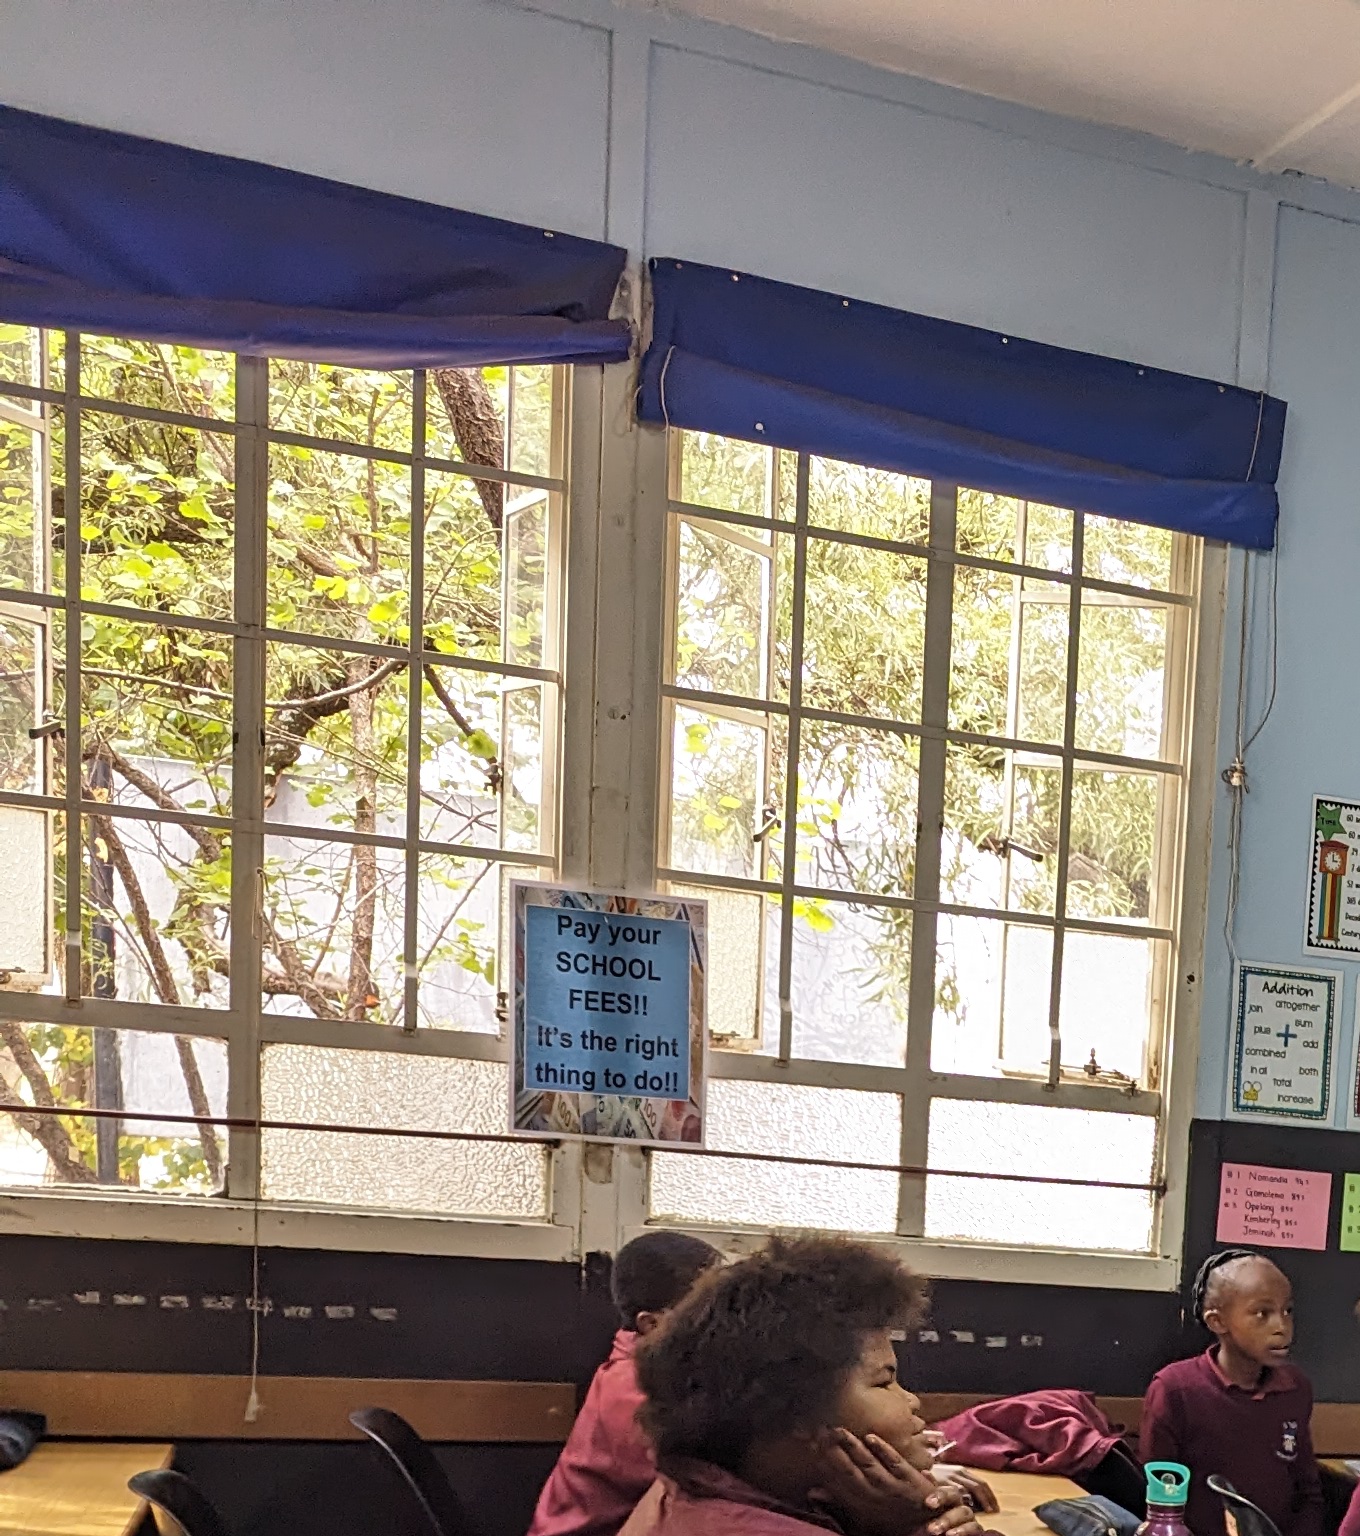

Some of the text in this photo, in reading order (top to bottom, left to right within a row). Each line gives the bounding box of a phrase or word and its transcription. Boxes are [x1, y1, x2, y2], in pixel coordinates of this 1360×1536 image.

[557, 915, 661, 946] Pay your
[556, 952, 661, 981] SCHOOL
[569, 989, 648, 1015] FEES!!
[1262, 982, 1313, 997] Addition
[537, 1025, 679, 1060] It's the right
[1245, 1048, 1286, 1059] combined
[535, 1063, 678, 1092] thing to do!!
